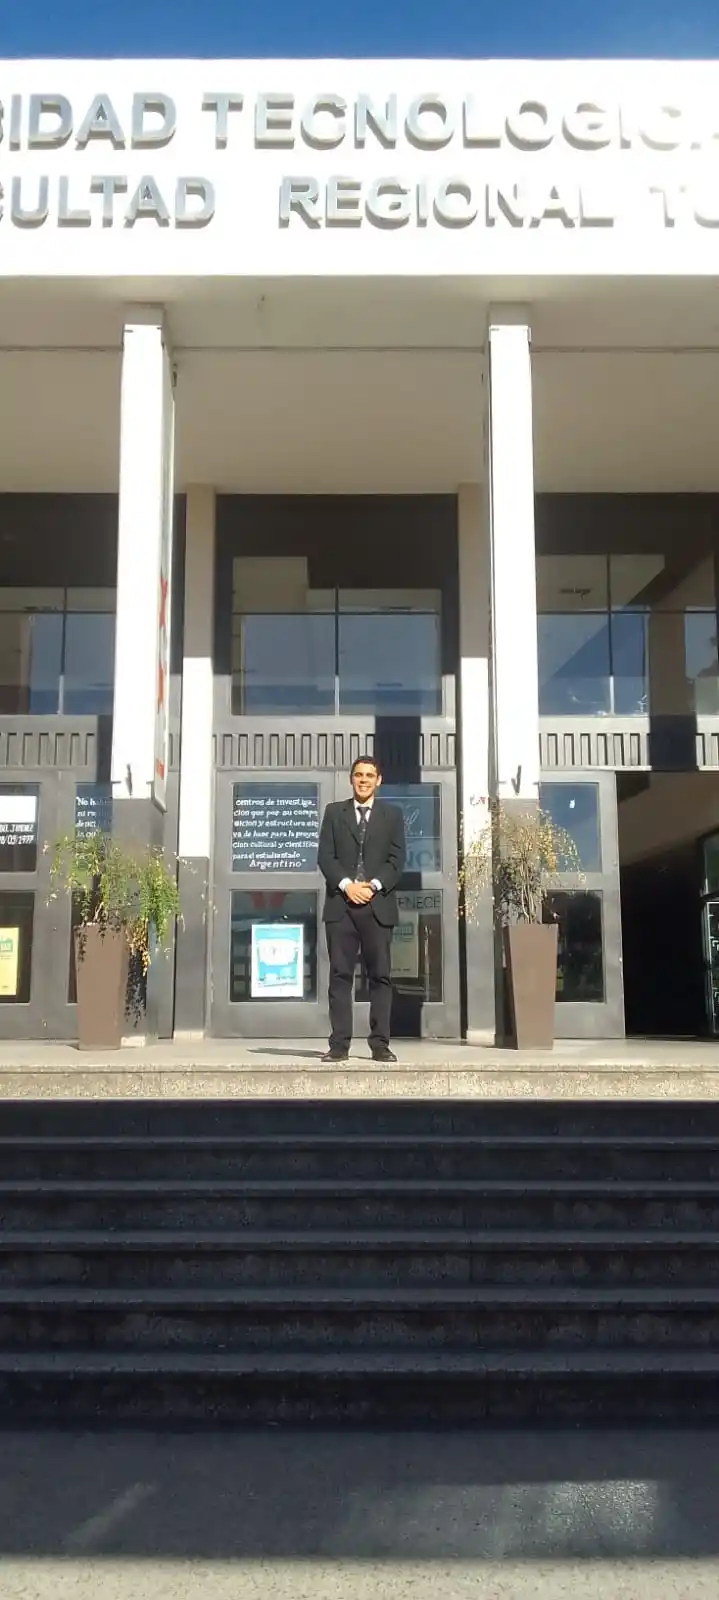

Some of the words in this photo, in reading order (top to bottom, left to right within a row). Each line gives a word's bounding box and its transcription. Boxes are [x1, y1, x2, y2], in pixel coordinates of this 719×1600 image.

[0, 93, 176, 150] IDAD
[0, 175, 215, 229] ULTAD
[278, 175, 615, 229] REGIONAL
[235, 798, 264, 806] centros
[265, 798, 275, 806] de
